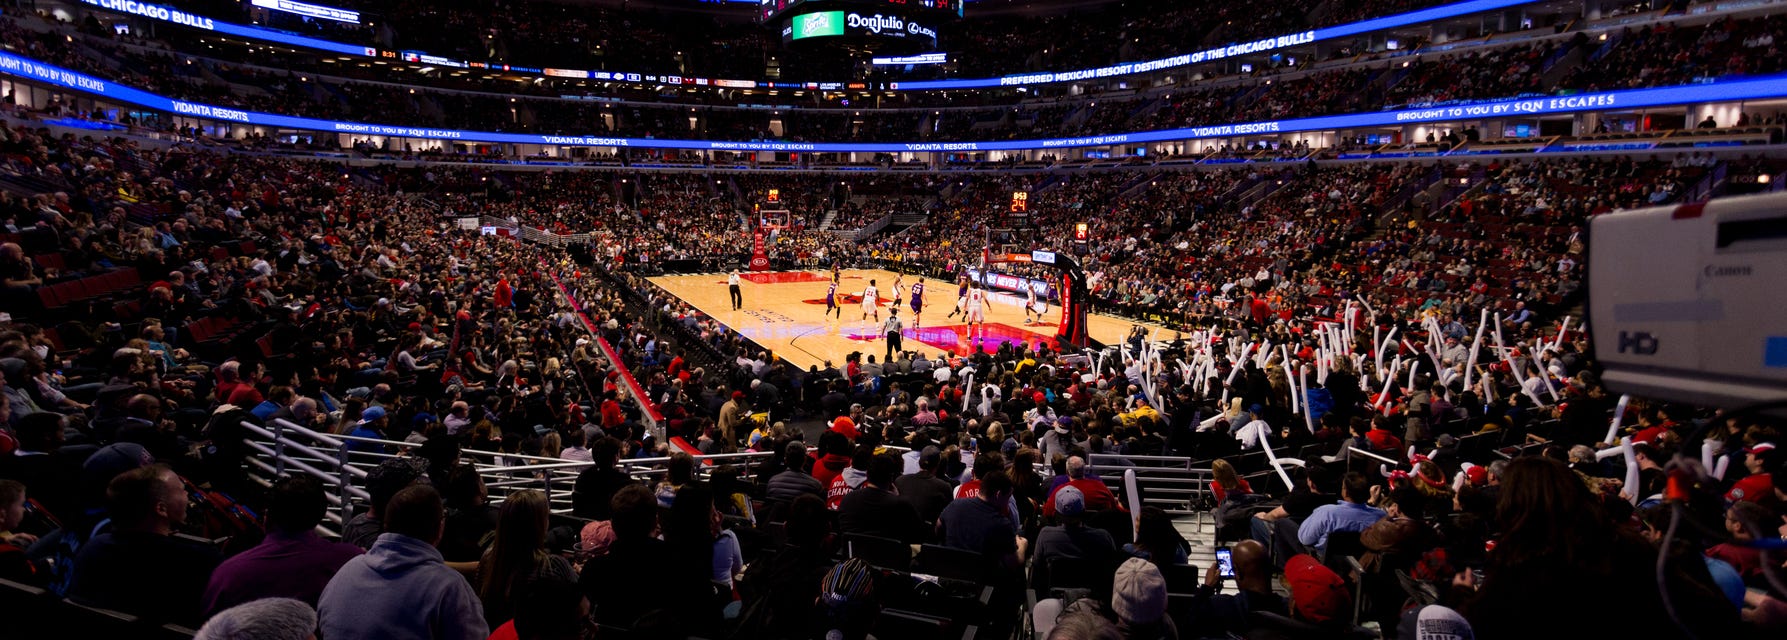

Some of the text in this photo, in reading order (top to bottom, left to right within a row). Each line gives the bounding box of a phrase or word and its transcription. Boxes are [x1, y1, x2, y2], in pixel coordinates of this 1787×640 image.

[100, 0, 213, 30] CHICAGO BULLS
[1001, 31, 1315, 85] PREFERRED MEXICAN RESORT DESTINATION OF THE CHICAGO BULLS
[22, 61, 32, 73] TO
[34, 66, 49, 78] YOU
[50, 70, 59, 80] BY
[61, 72, 76, 86] SQN
[78, 77, 104, 92] ESCAPES
[172, 101, 211, 116] VIDANTA
[1397, 111, 1444, 121] BROUGHT
[1448, 107, 1462, 117] TO
[1466, 106, 1489, 115] YOU
[1493, 104, 1508, 113] BY
[1514, 101, 1543, 113] SQN
[1550, 94, 1614, 109] ESCAPES
[336, 123, 369, 132] BROUGHT
[428, 130, 461, 138] ESCAPES
[1192, 126, 1232, 136] VIDANTA
[542, 136, 585, 144] VIDANTA
[1105, 135, 1127, 143] ESCAPES
[1012, 200, 1025, 211] 24
[1704, 264, 1752, 276] Canon
[997, 276, 1017, 288] NEVER
[1618, 331, 1658, 355] HD
